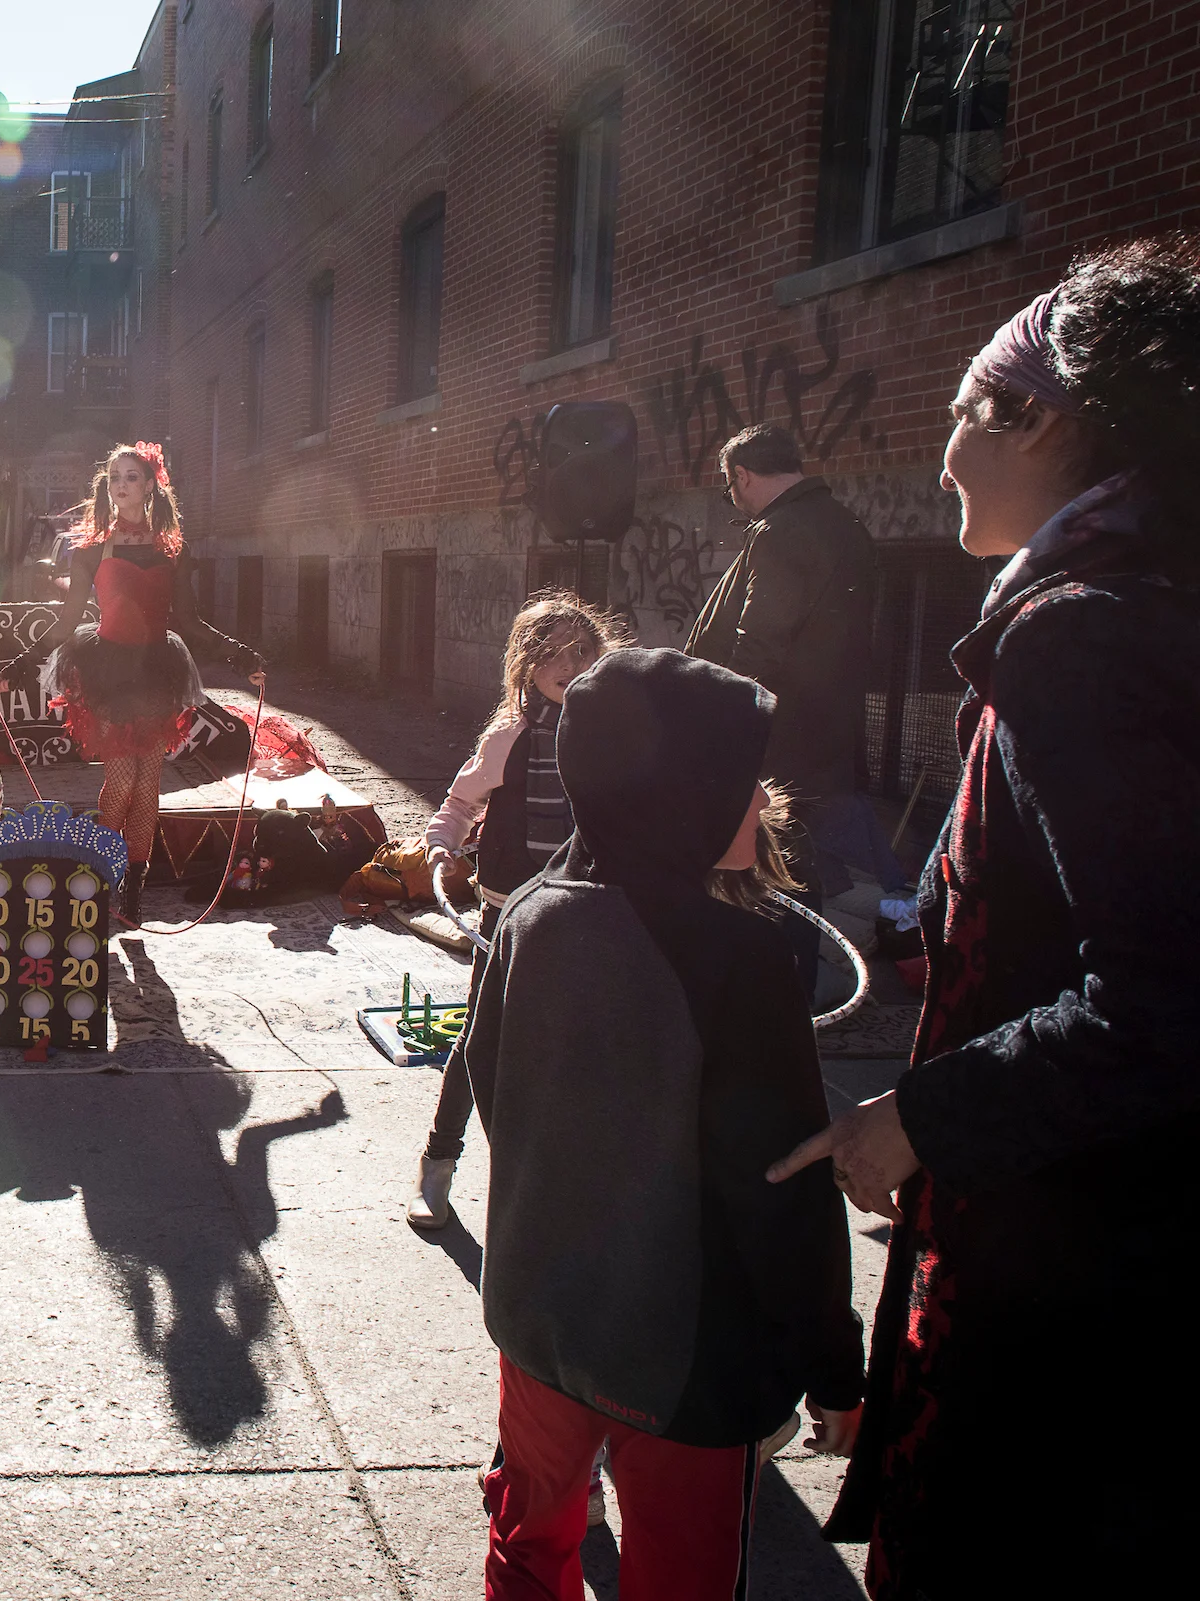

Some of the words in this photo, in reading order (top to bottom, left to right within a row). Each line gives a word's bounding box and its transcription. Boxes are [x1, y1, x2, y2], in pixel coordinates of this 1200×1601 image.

[25, 898, 54, 928] 15
[69, 899, 99, 928] 10
[17, 956, 55, 987] 25
[61, 957, 99, 988] 20
[19, 1017, 51, 1041] 15
[71, 1019, 90, 1041] 5
